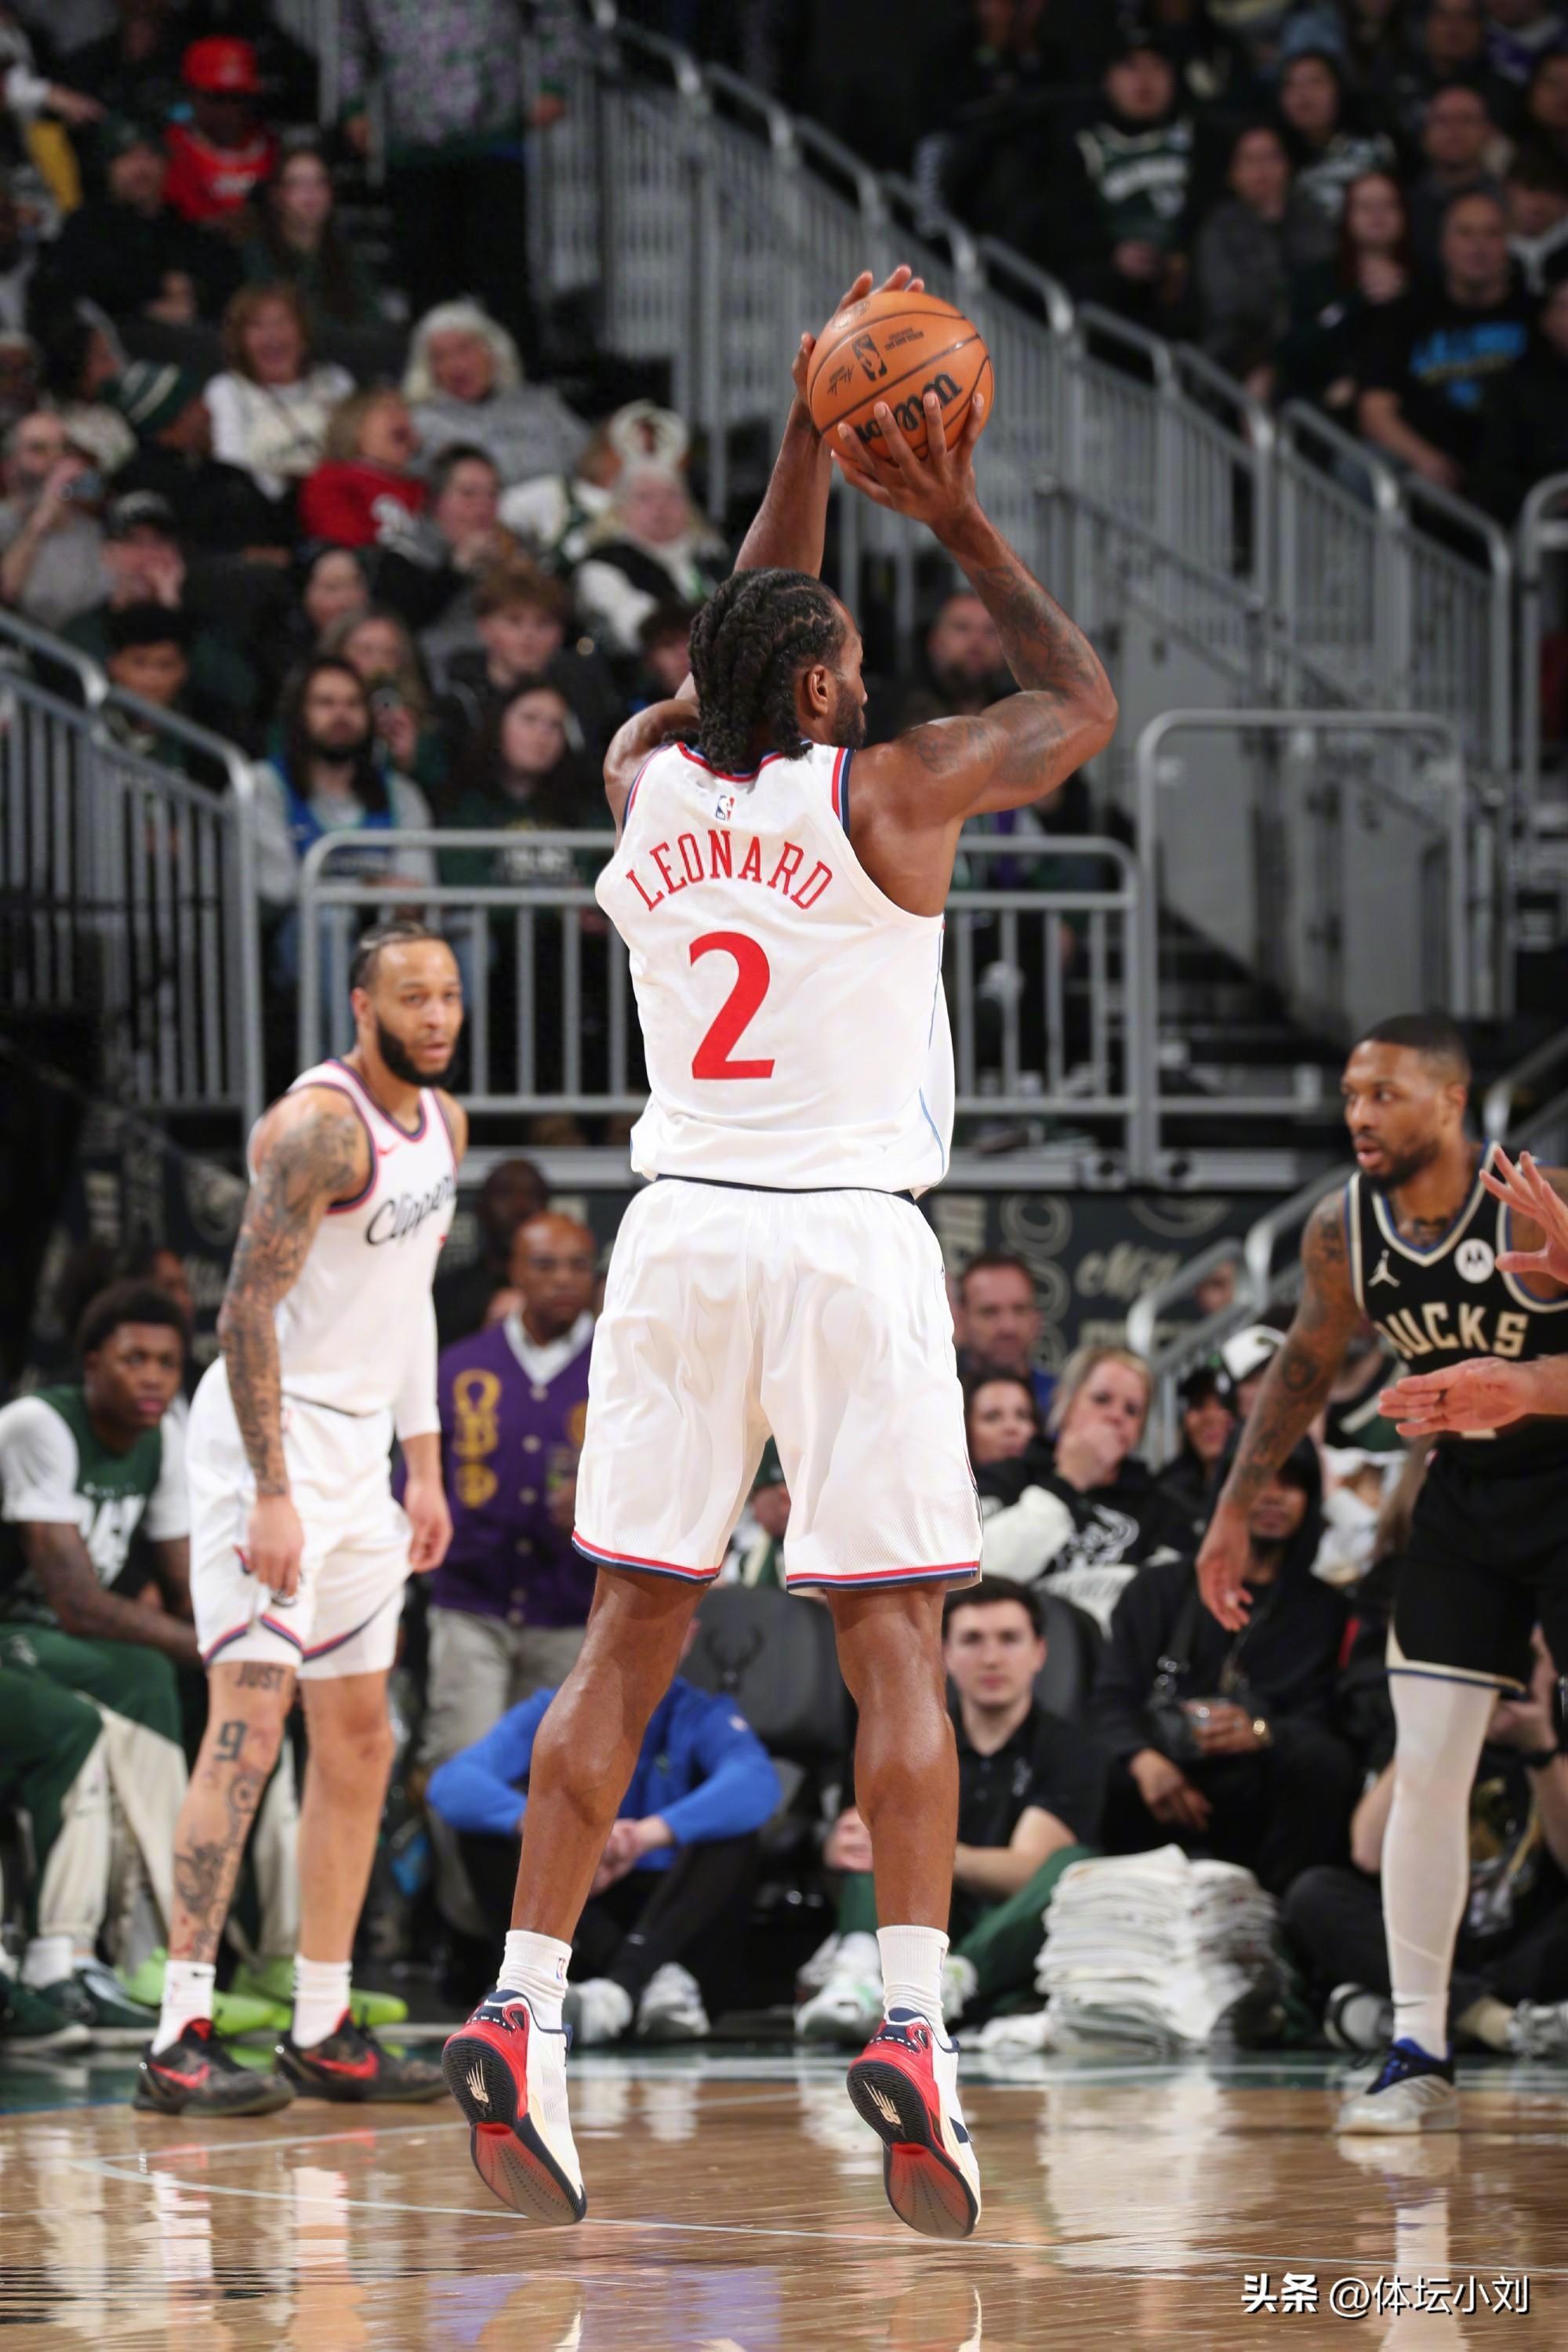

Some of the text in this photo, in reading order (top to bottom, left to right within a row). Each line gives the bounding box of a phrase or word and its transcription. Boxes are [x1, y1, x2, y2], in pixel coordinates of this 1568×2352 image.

[626, 829, 833, 912] LEONARD
[688, 931, 775, 1080] 2
[1374, 1301, 1528, 1359] UCKS
